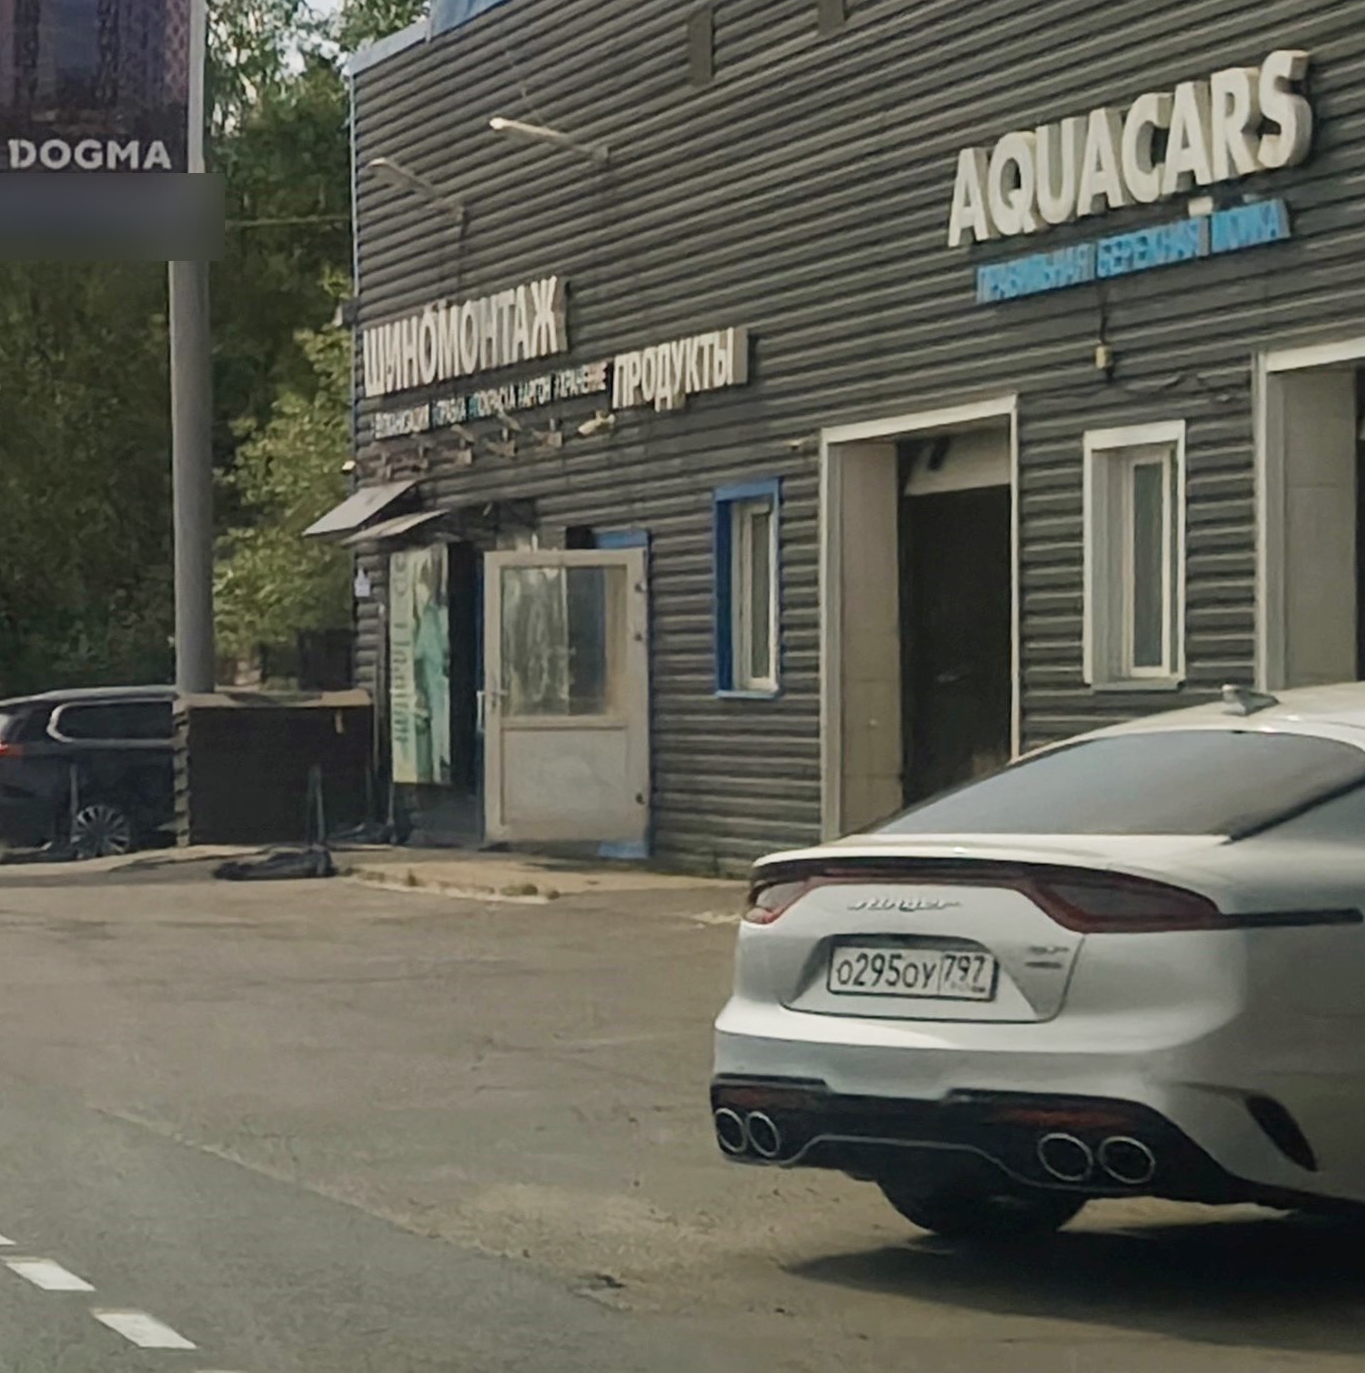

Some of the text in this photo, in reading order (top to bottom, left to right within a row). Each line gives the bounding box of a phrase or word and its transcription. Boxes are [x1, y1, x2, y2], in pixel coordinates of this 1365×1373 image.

[7, 138, 173, 170] DOGMA
[948, 49, 1312, 247] AQUACARS
[363, 275, 562, 397] ШИНОМОНТАЖ
[612, 327, 738, 412] ПРОДУКТЫ
[944, 954, 986, 984] 797
